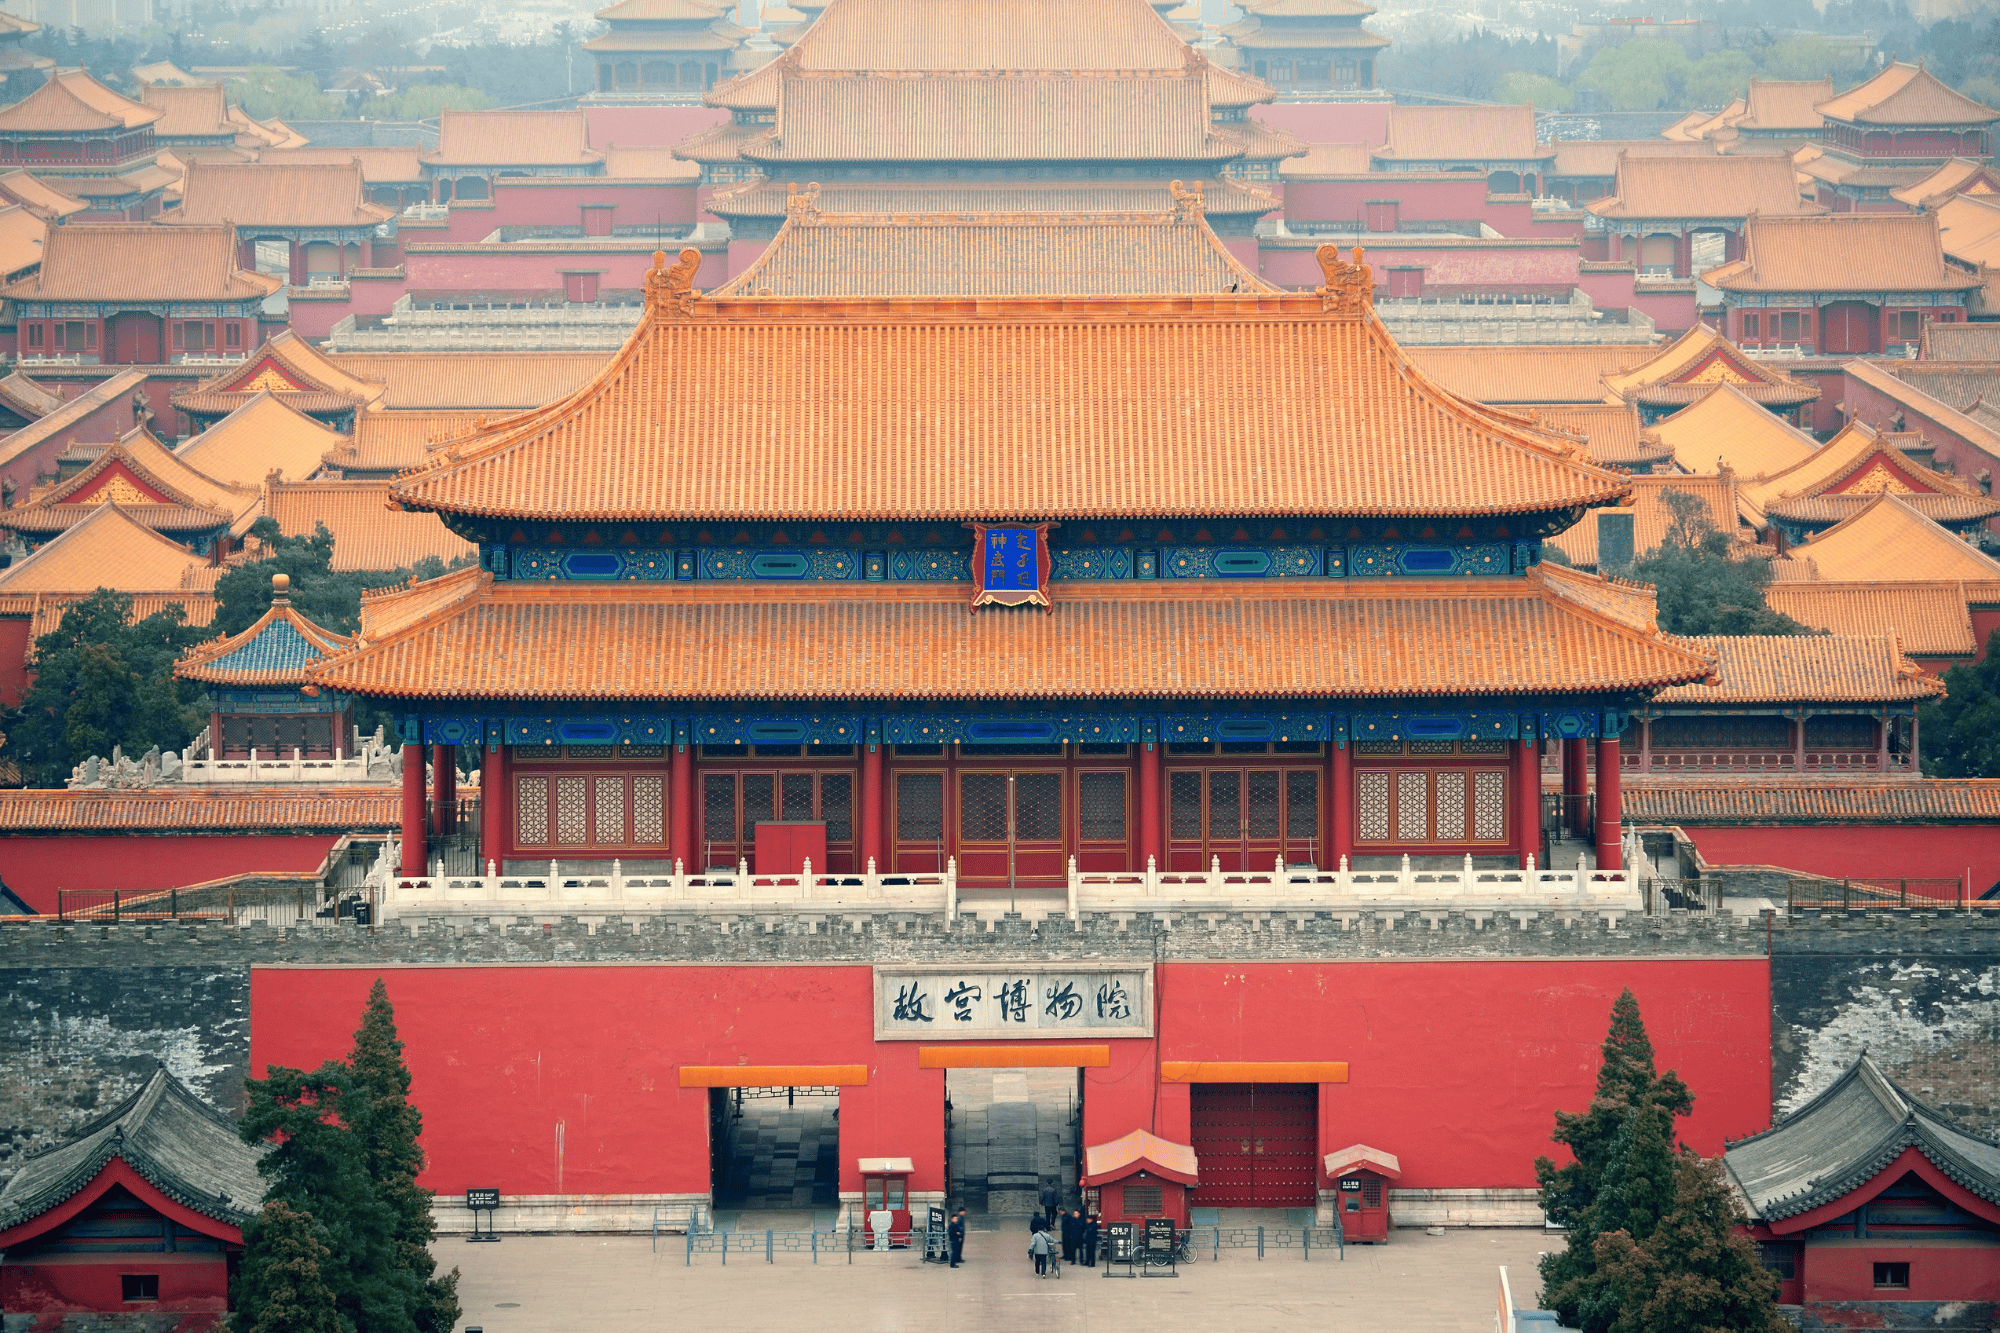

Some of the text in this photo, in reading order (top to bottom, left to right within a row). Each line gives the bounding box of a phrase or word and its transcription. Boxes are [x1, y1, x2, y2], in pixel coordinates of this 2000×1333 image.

[991, 532, 1008, 587] 神武門
[893, 979, 1131, 1023] 故宫博物院
